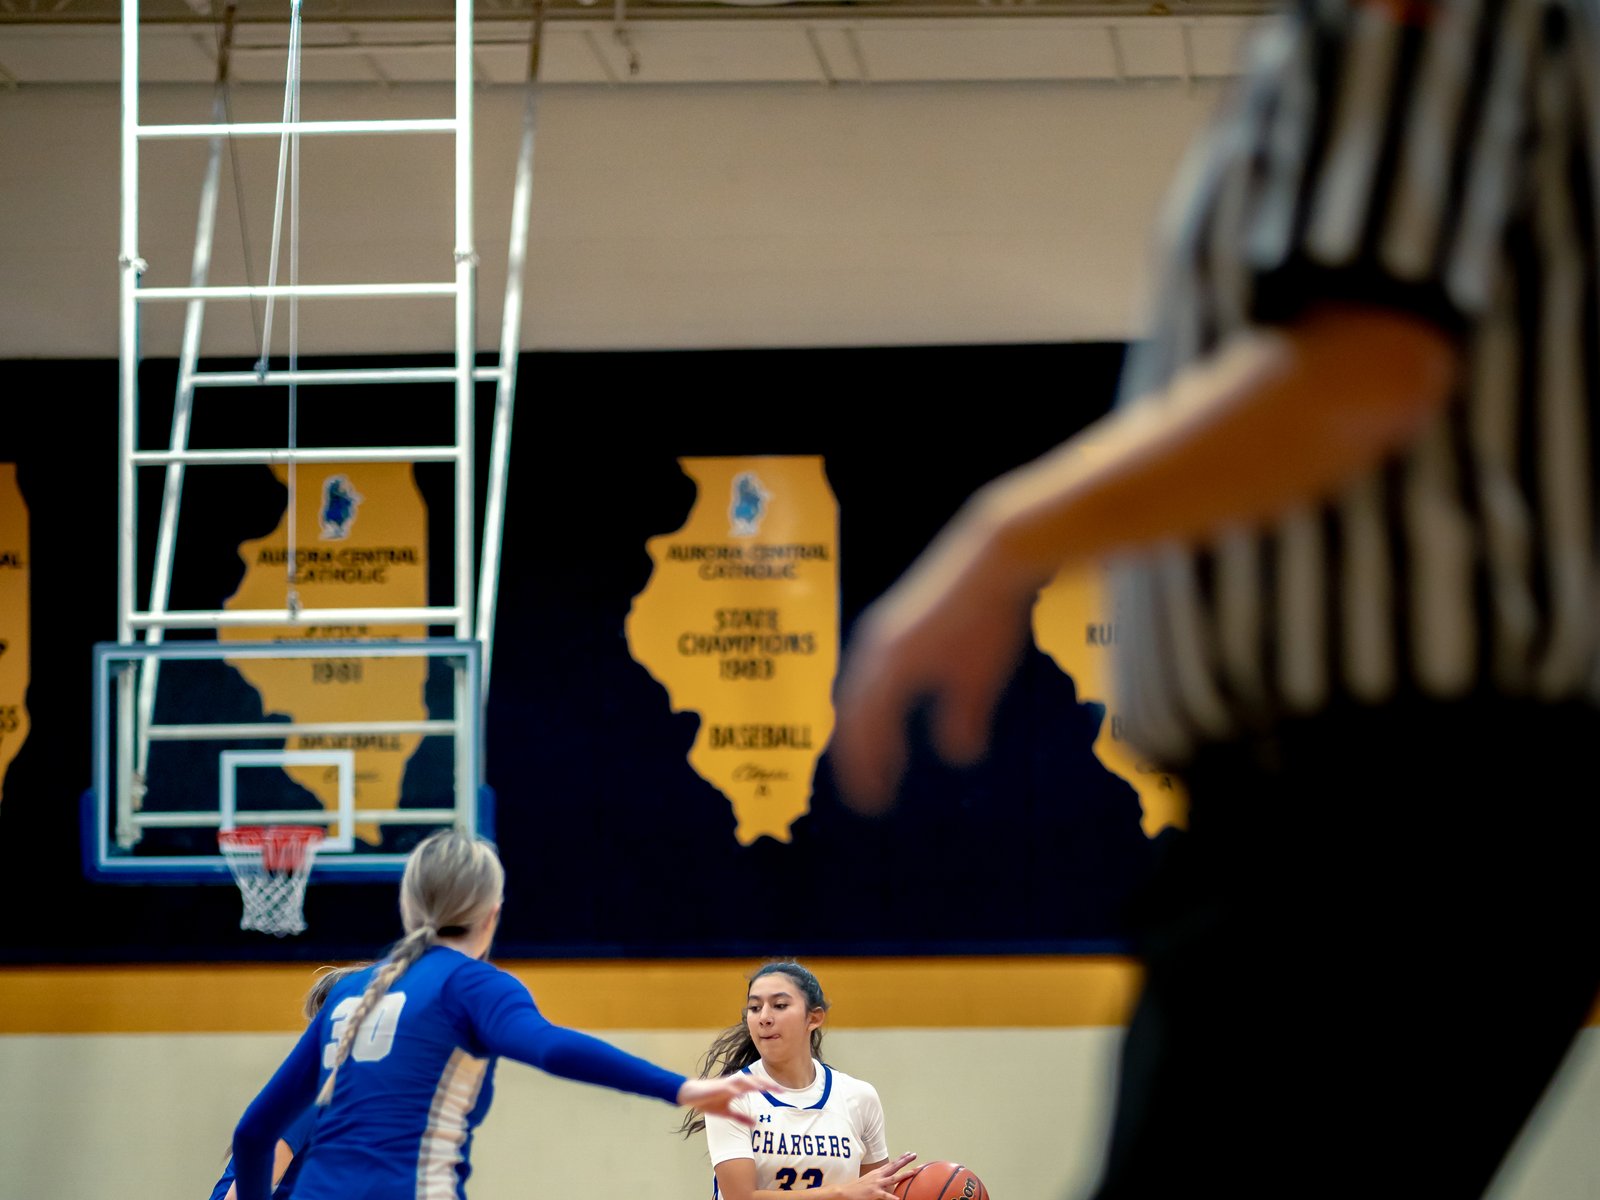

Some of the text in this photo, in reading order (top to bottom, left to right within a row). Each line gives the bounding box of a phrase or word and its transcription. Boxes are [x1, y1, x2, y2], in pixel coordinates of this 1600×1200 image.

[338, 548, 417, 565] CENTRAL
[667, 545, 829, 561] AURORA CENTRAL
[699, 563, 797, 580] CATHOLIC
[715, 608, 779, 631] STATE
[677, 632, 816, 656] CHAMPIONS
[709, 724, 813, 750] BASEBALL
[751, 1129, 851, 1159] CHARGERS
